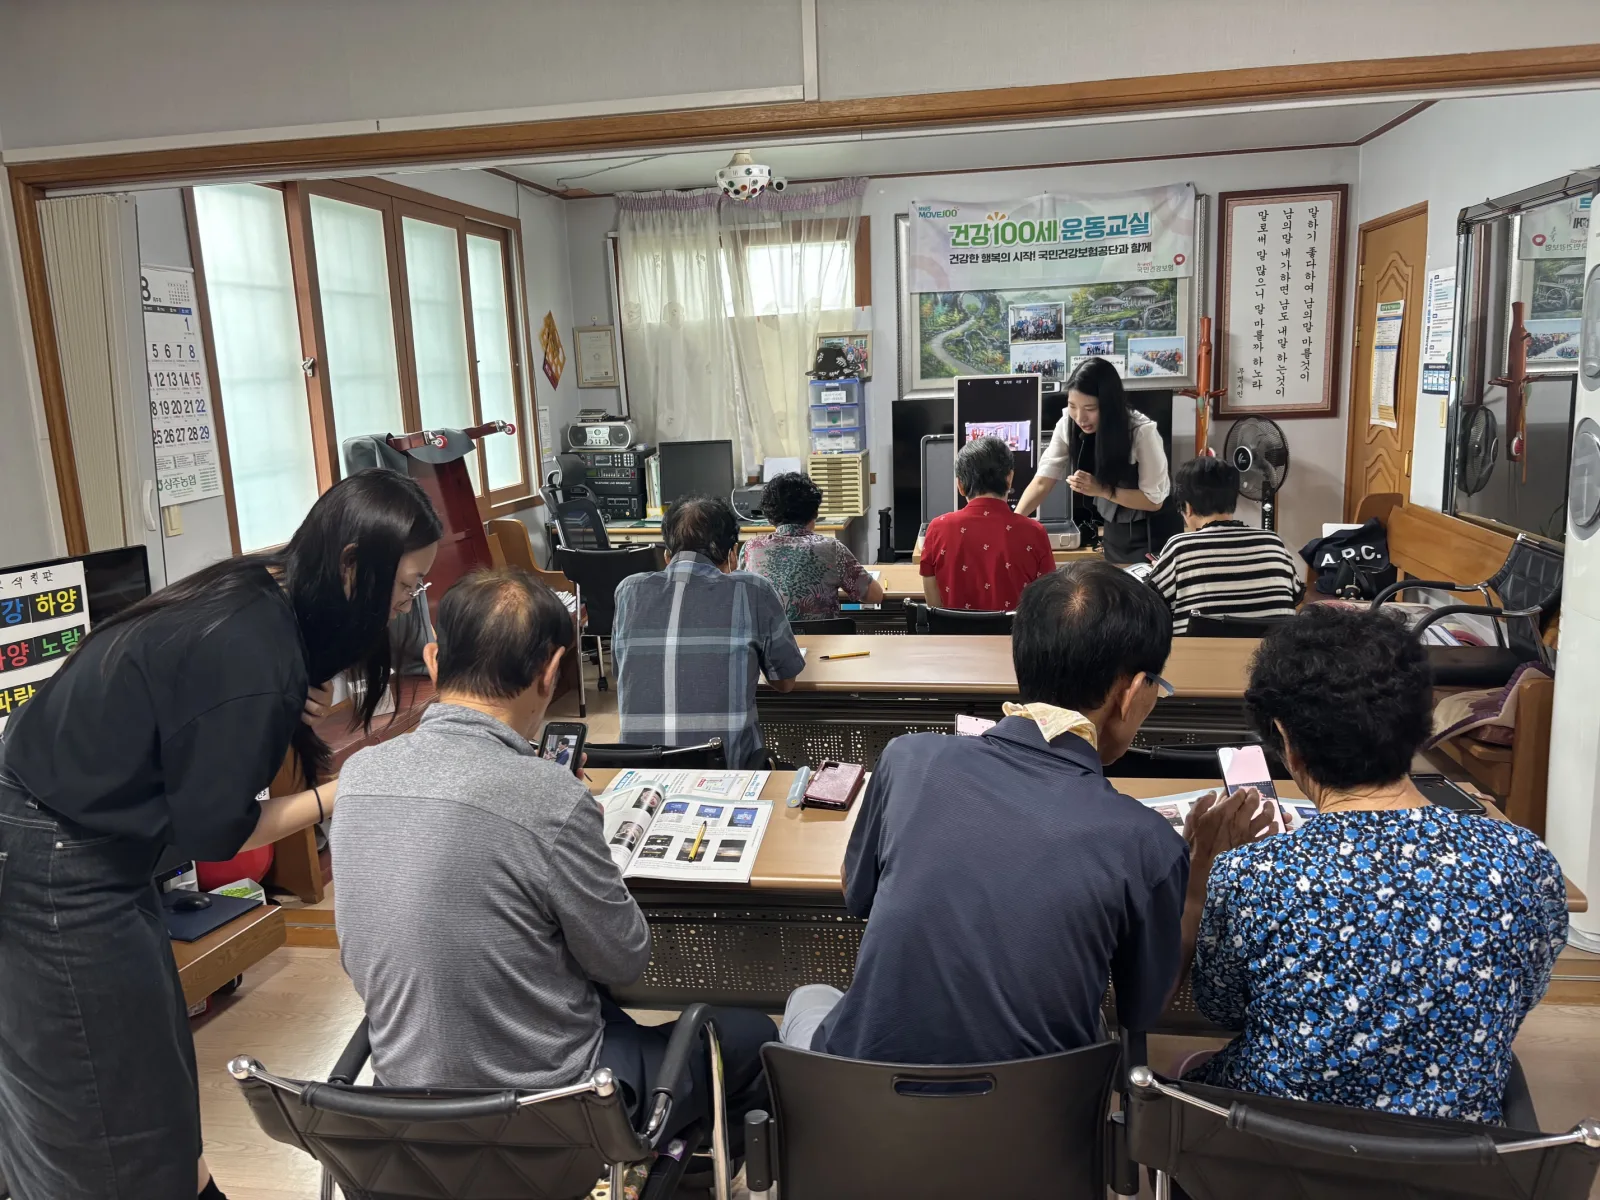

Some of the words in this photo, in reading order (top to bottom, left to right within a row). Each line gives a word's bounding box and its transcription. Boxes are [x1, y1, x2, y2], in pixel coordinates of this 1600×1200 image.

[949, 220, 1057, 247] 건강100세
[1061, 212, 1149, 241] 운동교실
[949, 253, 979, 265] 건강한
[981, 252, 1010, 263] 행복의
[1013, 250, 1036, 262] 시작!
[1038, 244, 1129, 261] 국민건강보험공단과
[1131, 242, 1152, 254] 함께
[1137, 264, 1174, 274] 국민건강보험
[152, 344, 159, 358] 5
[164, 344, 171, 358] 6
[177, 344, 183, 358] 7
[189, 344, 196, 358] 8
[154, 372, 165, 387] 12
[166, 372, 178, 387] 13
[179, 372, 190, 387] 14
[191, 372, 202, 386] 15
[151, 401, 158, 416] 8
[159, 400, 170, 415] 19
[171, 400, 182, 414] 20
[184, 400, 194, 414] 21
[195, 399, 206, 413] 22
[163, 429, 175, 443] 26
[175, 428, 185, 442] 27
[188, 427, 198, 441] 28
[200, 426, 210, 440] 29
[164, 474, 197, 490] 상주농협
[35, 588, 78, 617] 하양
[0, 641, 30, 671] 양
[41, 628, 81, 658] 노랑
